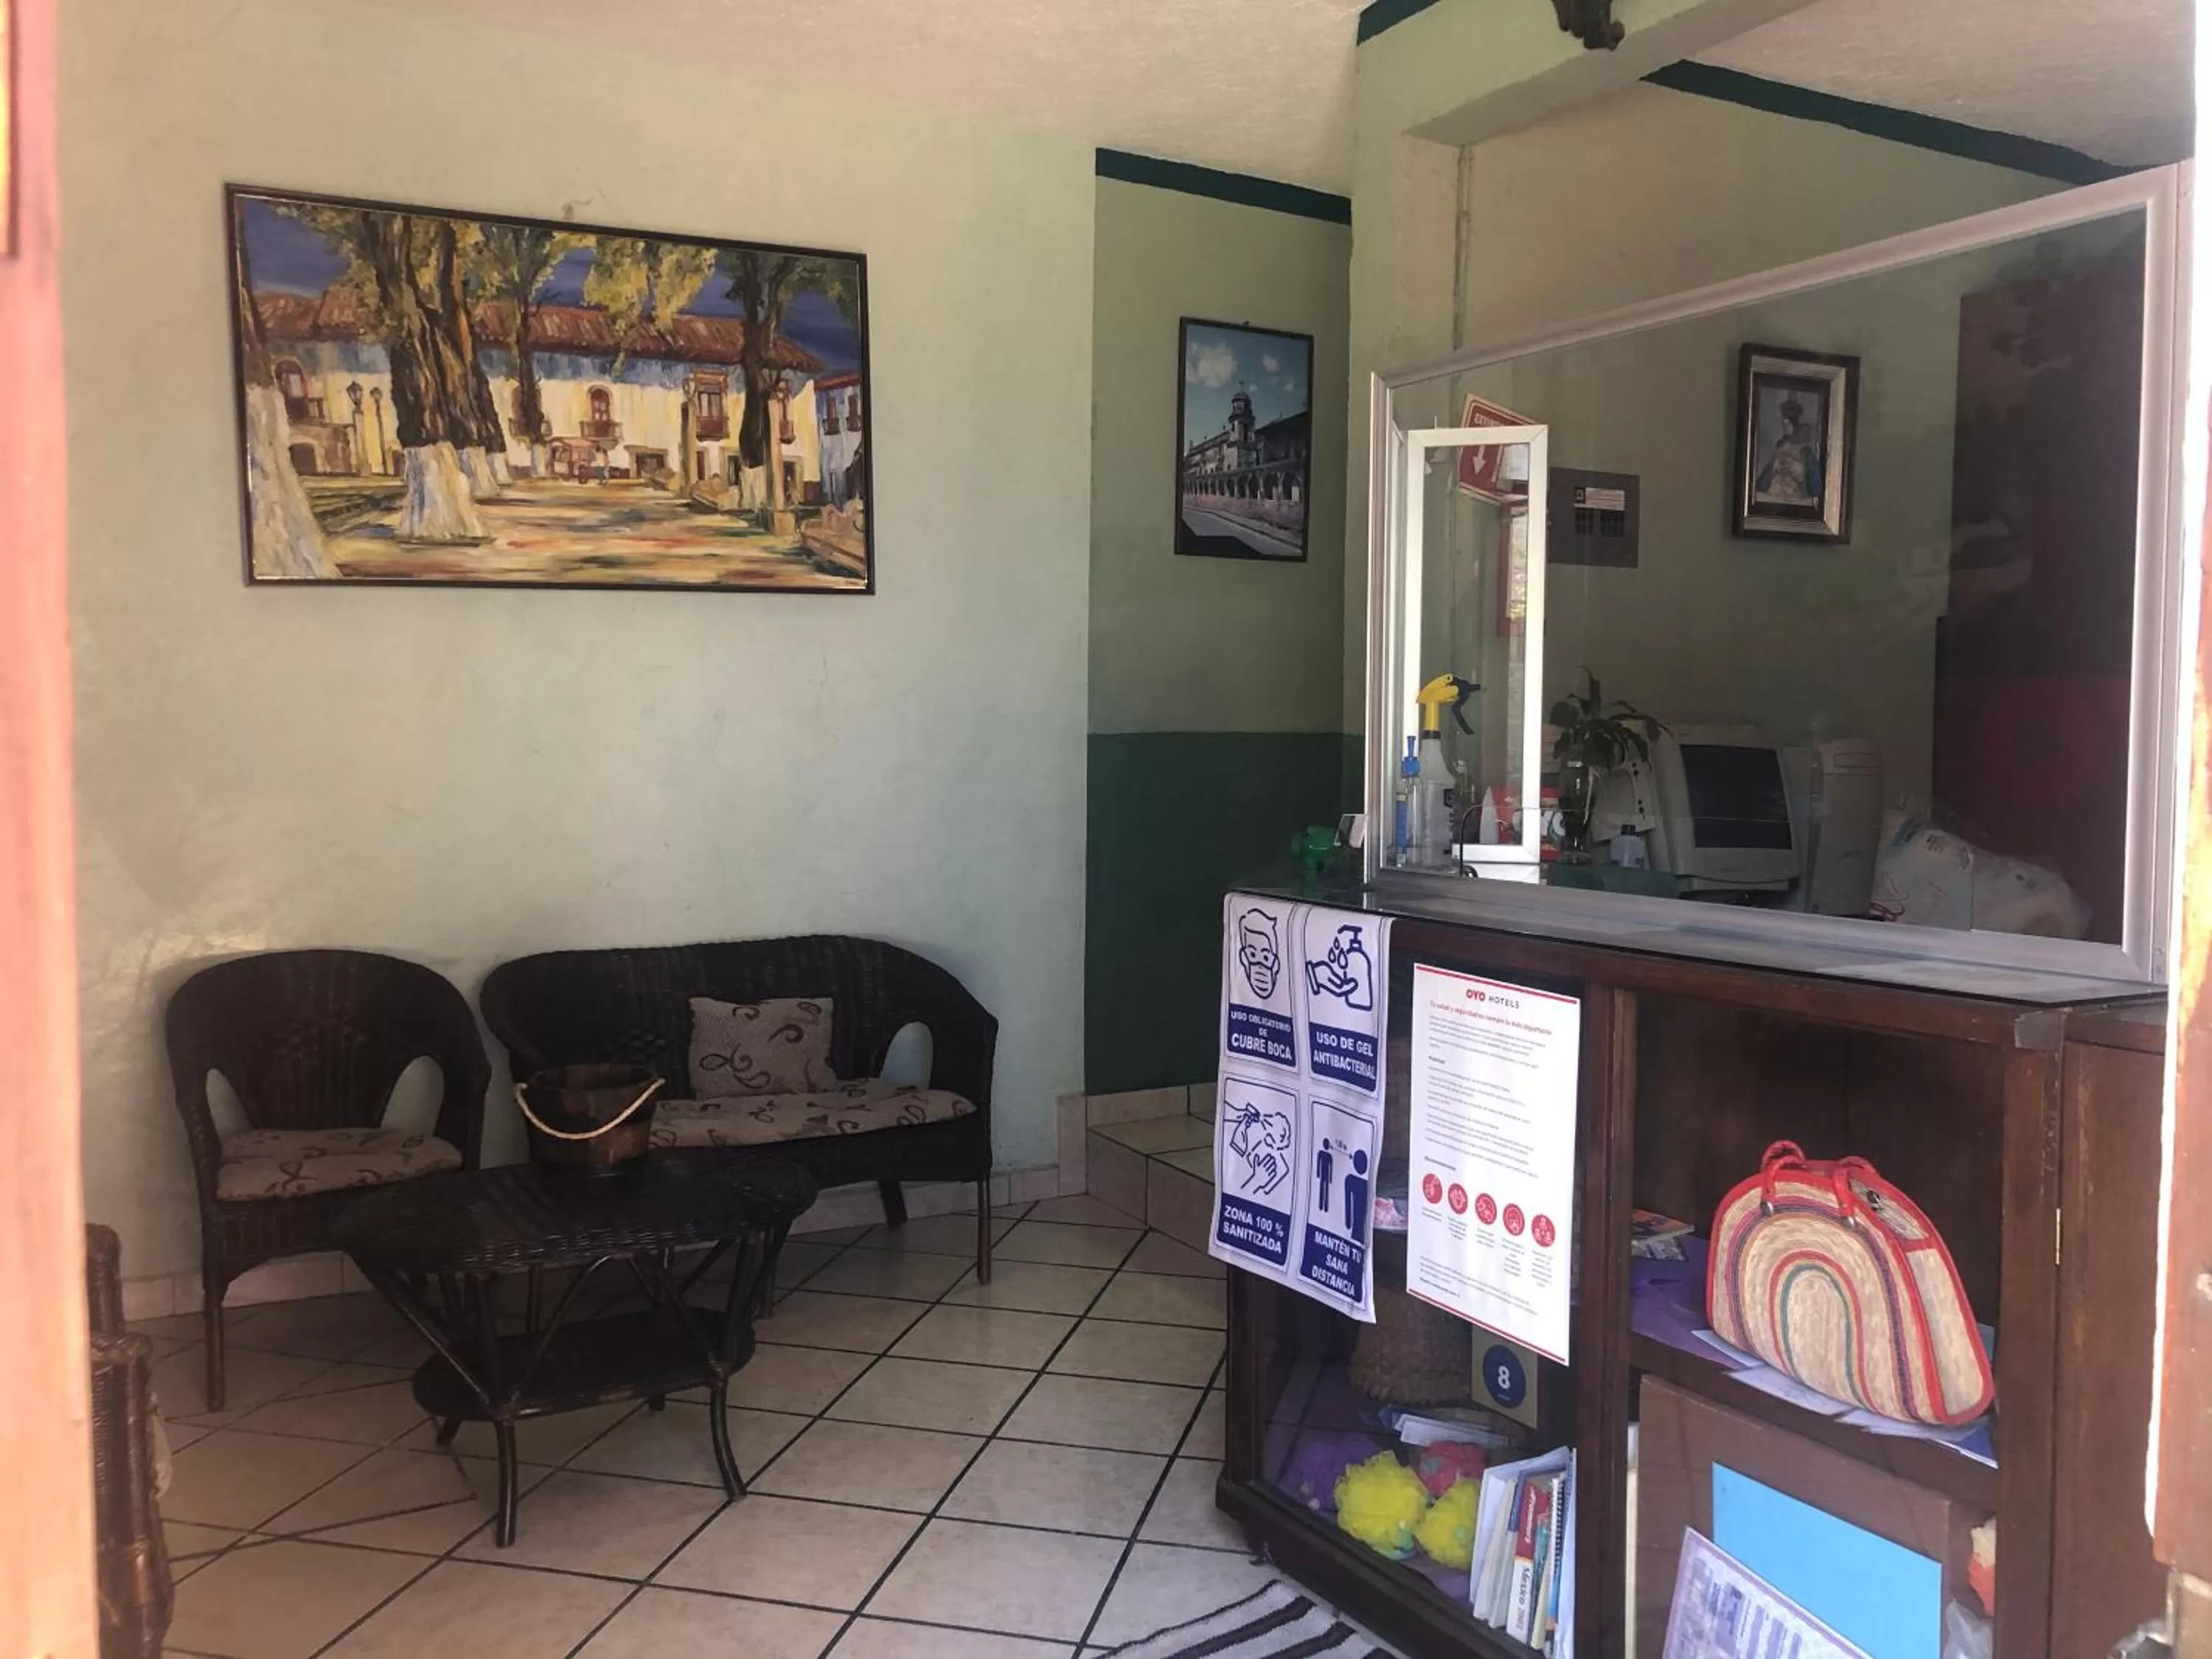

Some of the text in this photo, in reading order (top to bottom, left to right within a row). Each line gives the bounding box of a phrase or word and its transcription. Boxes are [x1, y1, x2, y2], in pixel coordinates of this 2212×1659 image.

[1466, 989, 1520, 1009] OYO HOTELS
[1231, 1011, 1291, 1032] USO OBLIGATORIO
[1259, 1028, 1267, 1037] DE
[1231, 1033, 1293, 1060] CUBRE BOCA
[1316, 1032, 1374, 1057] USO DE GEL
[1313, 1049, 1376, 1080] ANTIBACTERIAL
[1225, 1205, 1284, 1237] ZONA 100 %
[1223, 1222, 1282, 1254] SANITIZADA
[1314, 1230, 1363, 1264] MANTÉN TU
[1325, 1253, 1349, 1275] SANA
[1312, 1265, 1355, 1296] DISTANCIA
[1498, 1365, 1510, 1390] 8
